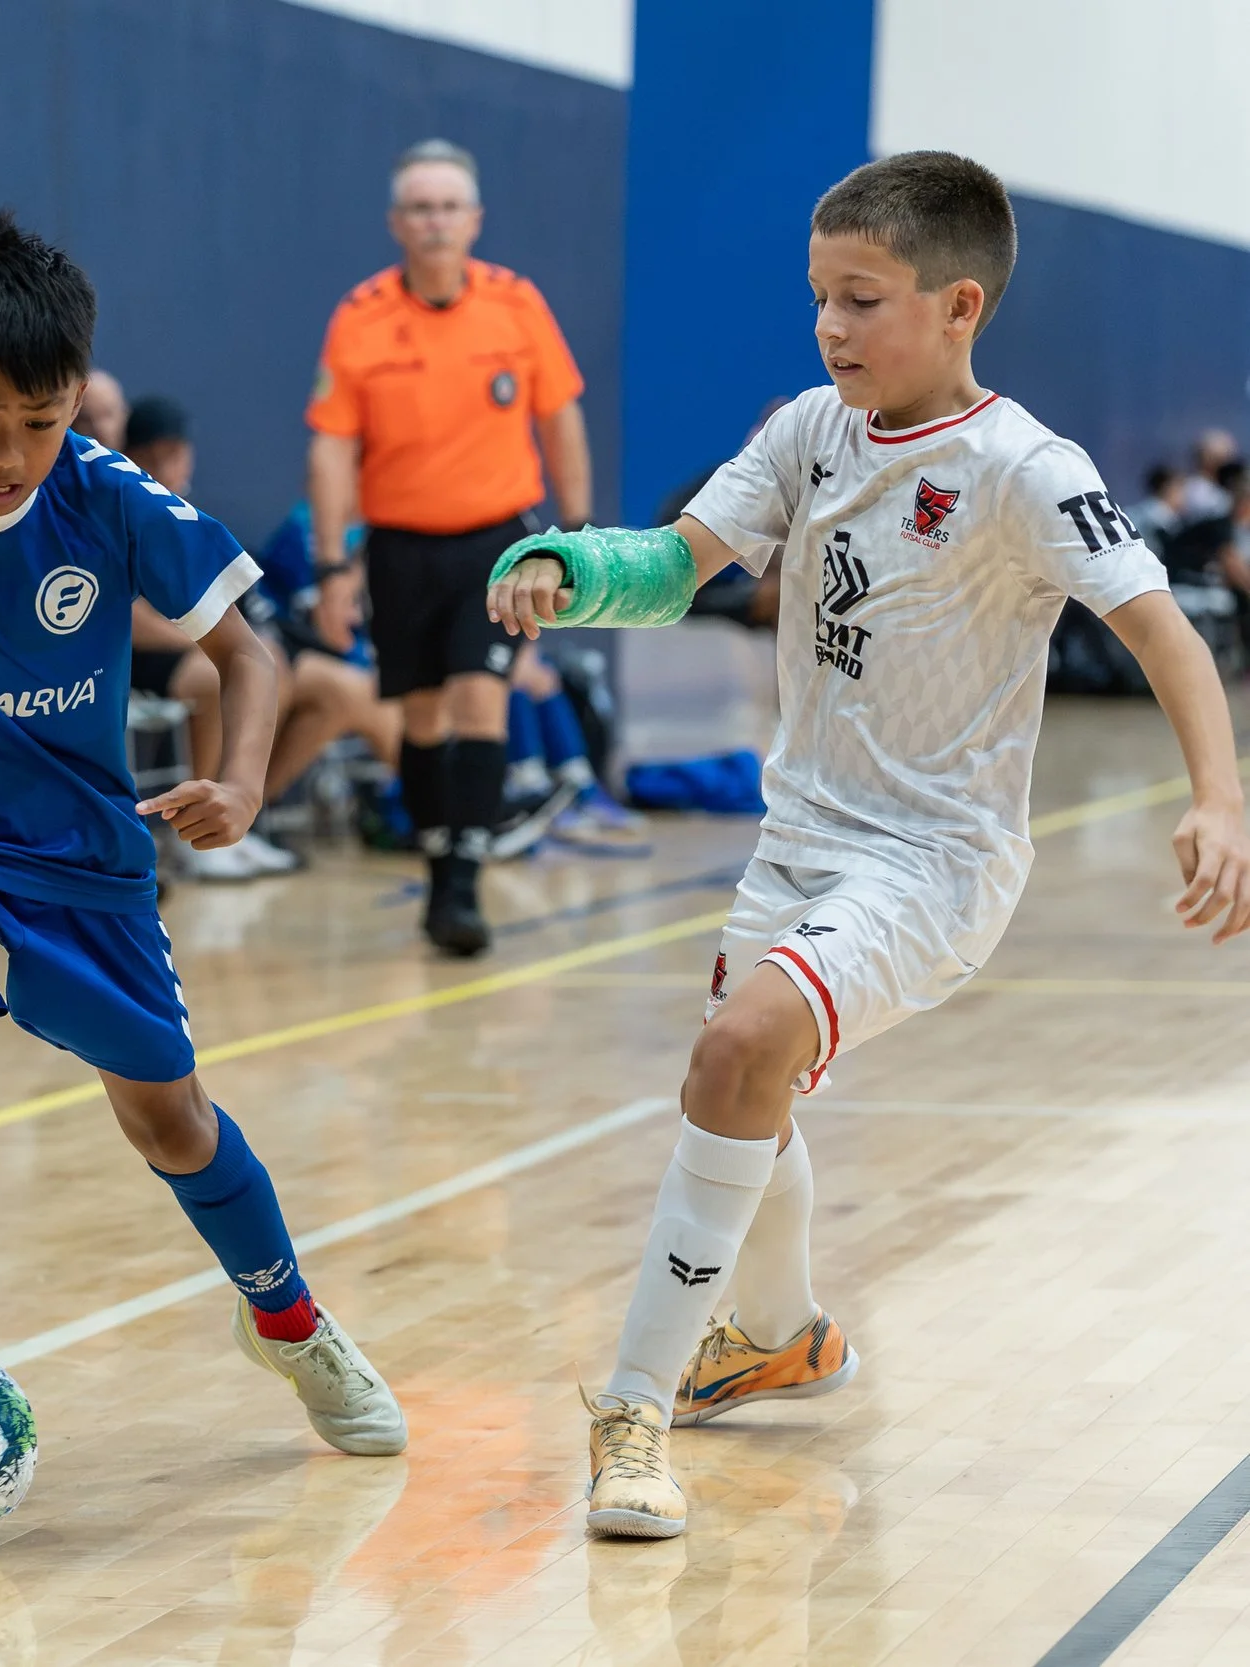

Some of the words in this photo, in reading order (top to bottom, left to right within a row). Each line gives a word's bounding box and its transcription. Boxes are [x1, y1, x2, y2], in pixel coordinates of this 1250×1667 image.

[900, 531, 921, 544] FUTSAL
[922, 538, 941, 550] CLUB
[901, 517, 950, 543] TEKKERS
